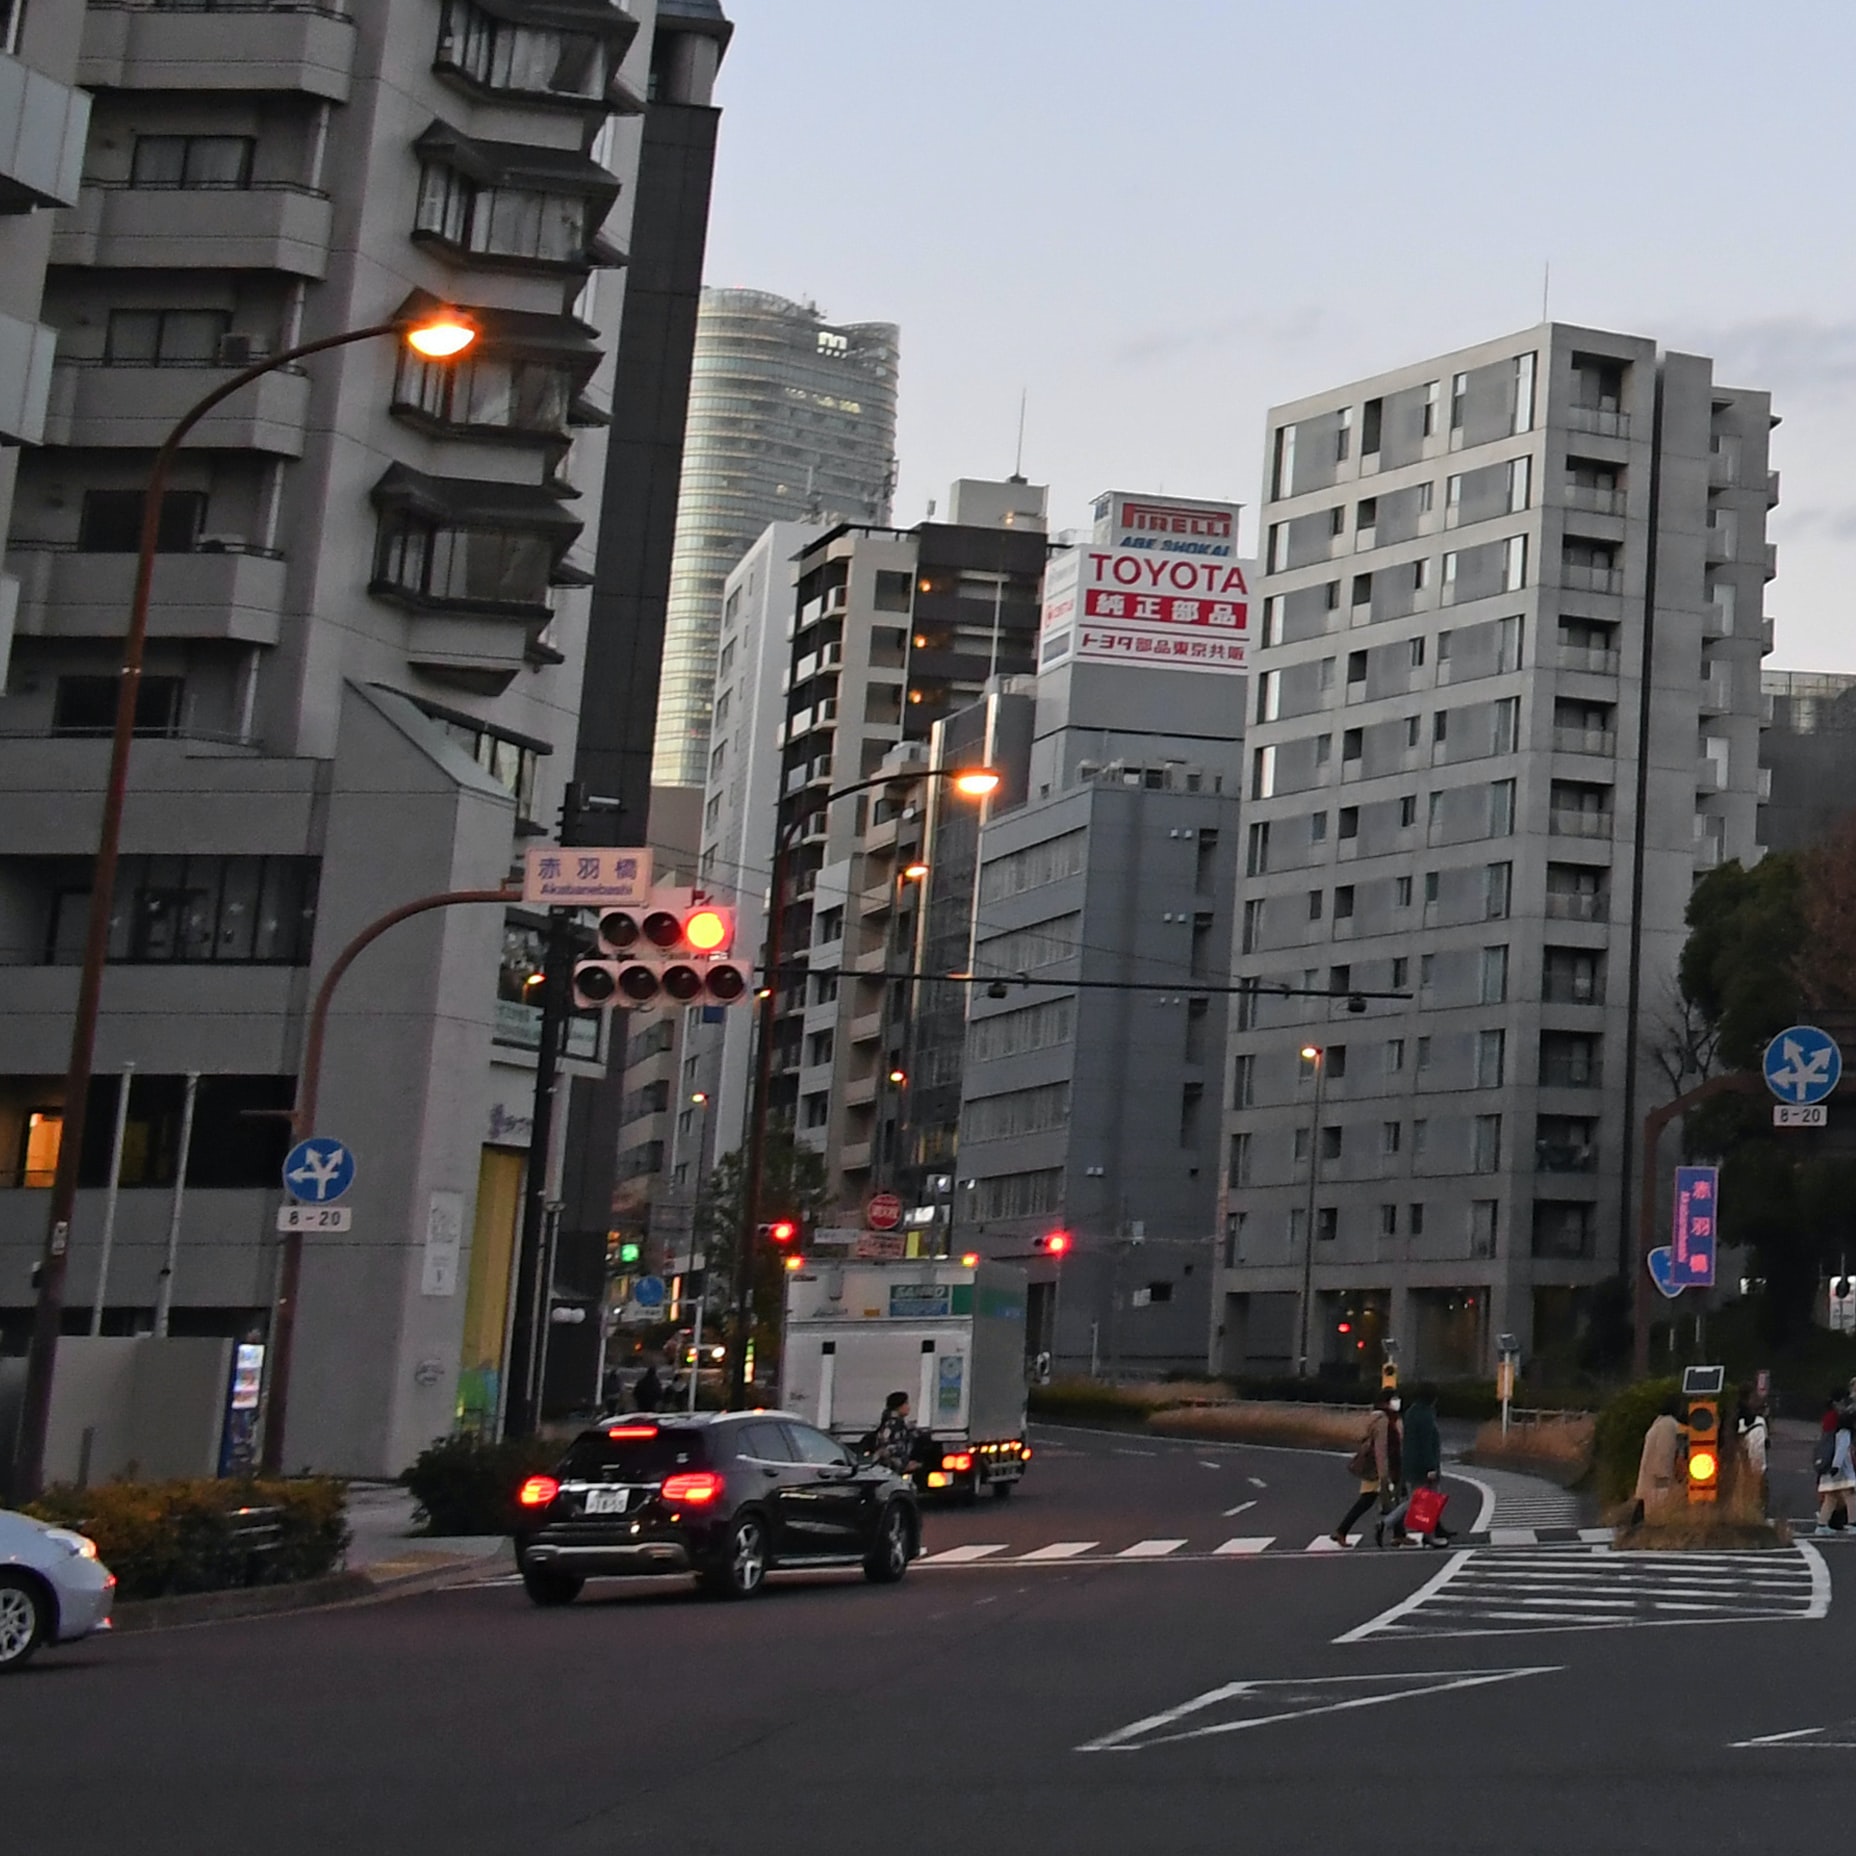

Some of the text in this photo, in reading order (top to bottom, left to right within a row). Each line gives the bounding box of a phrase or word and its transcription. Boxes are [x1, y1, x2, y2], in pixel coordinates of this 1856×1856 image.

[1121, 502, 1233, 538] PIRELLI
[1119, 535, 1154, 549] ABE
[1088, 552, 1249, 596] TOYOTA
[1095, 592, 1237, 626] 純正部品
[538, 856, 637, 880] 赤羽橋
